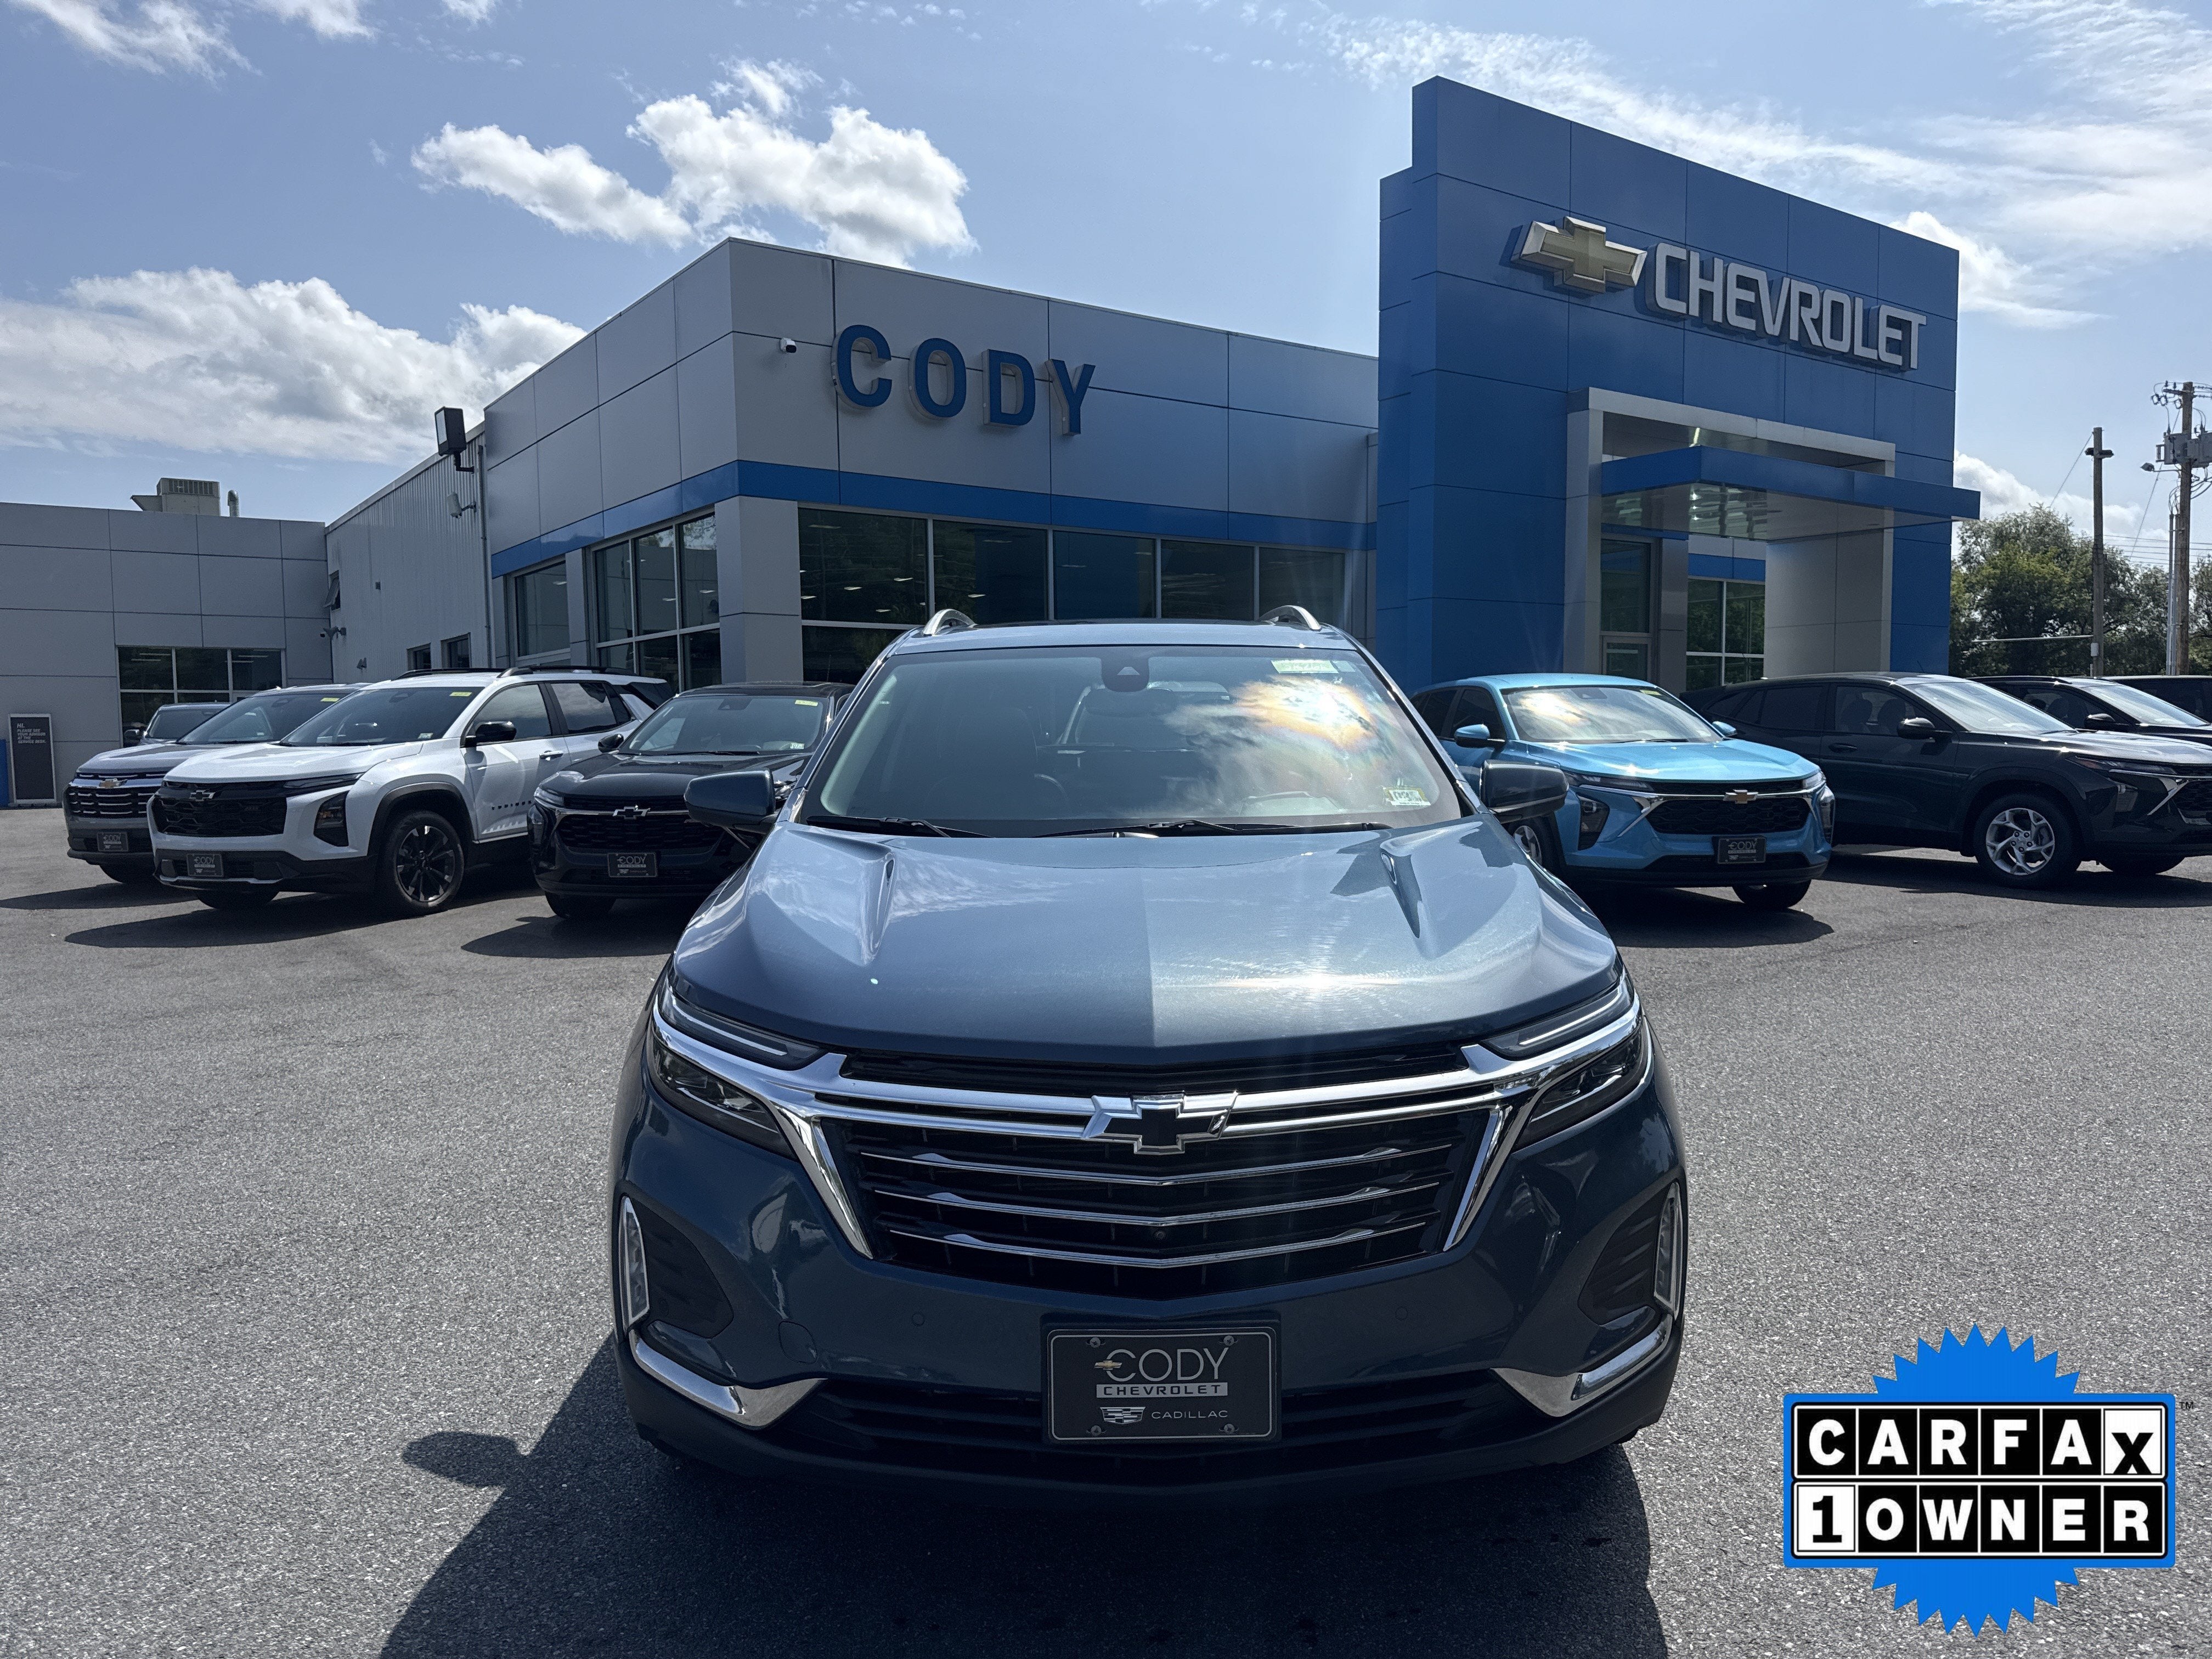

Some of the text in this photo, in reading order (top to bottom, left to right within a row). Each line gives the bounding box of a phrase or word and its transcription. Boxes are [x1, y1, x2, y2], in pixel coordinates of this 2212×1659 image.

[1647, 242, 1927, 370] CHEVROLET
[832, 324, 1096, 436] CODY
[1730, 841, 1757, 850] CODY
[619, 856, 646, 864] CODY
[1105, 1347, 1229, 1382] CODY
[1103, 1384, 1221, 1396] CHEVROLET
[1151, 1410, 1228, 1419] CADILLAC
